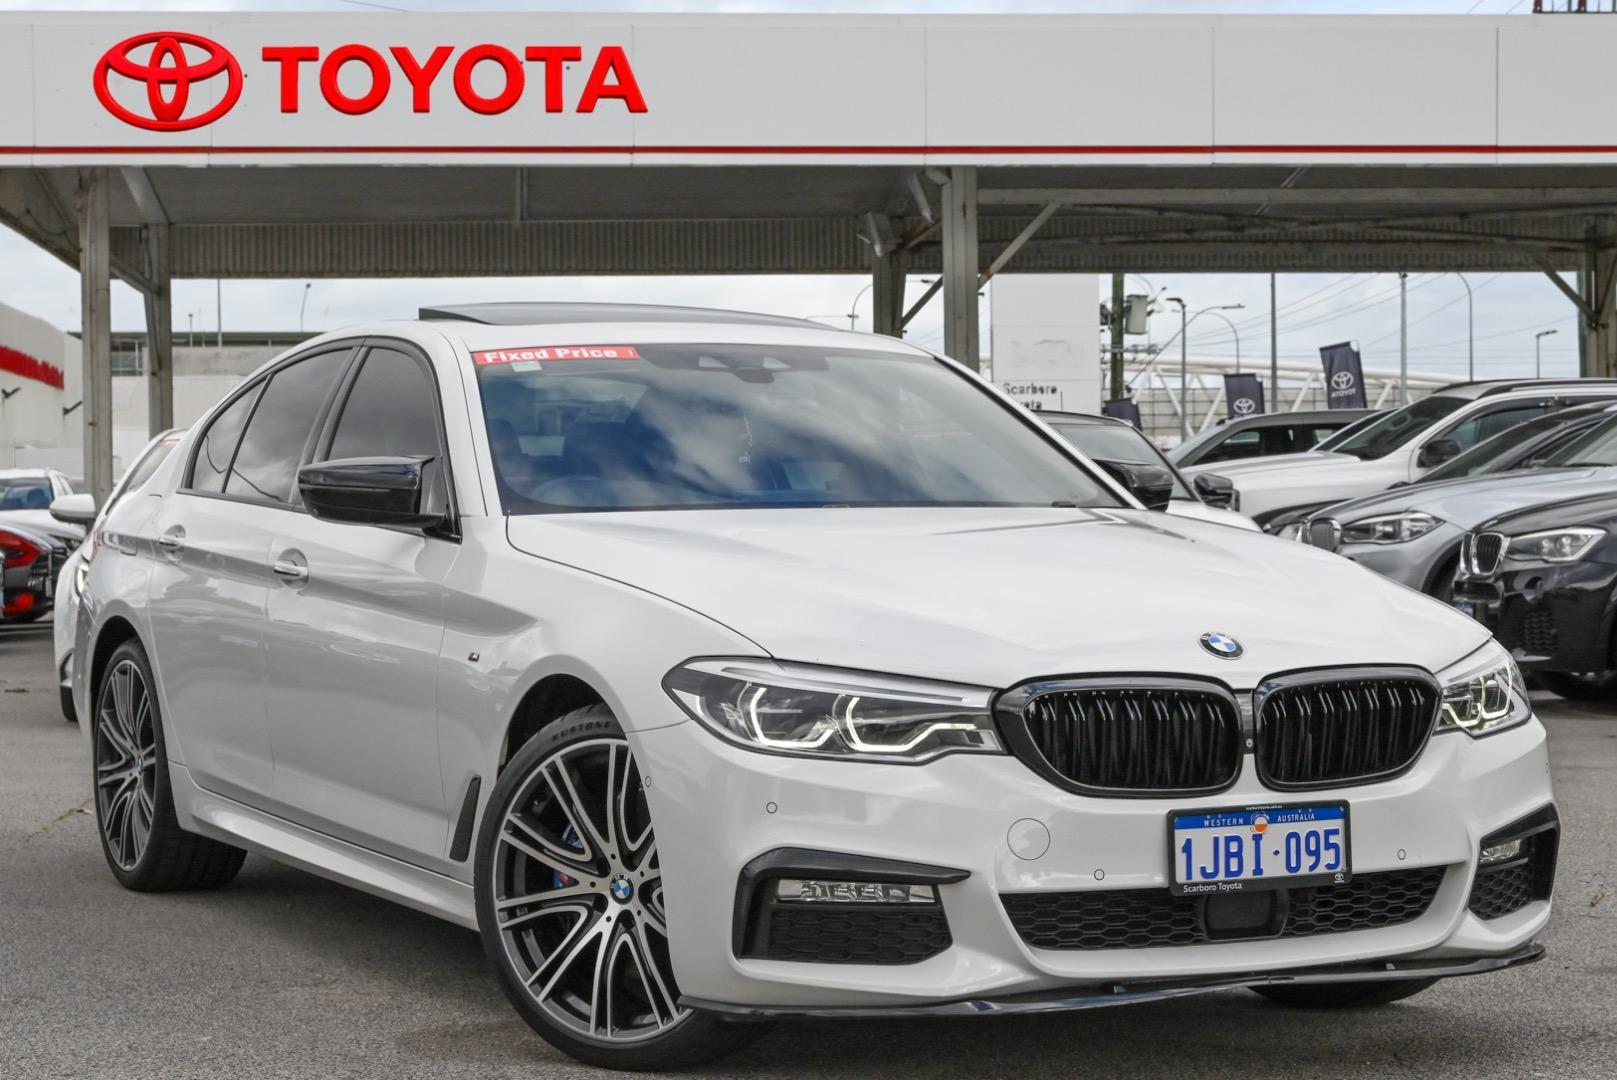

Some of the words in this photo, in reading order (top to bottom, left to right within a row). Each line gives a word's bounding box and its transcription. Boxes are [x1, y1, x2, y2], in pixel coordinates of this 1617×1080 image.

[262, 43, 648, 115] TOYOTA
[484, 349, 549, 363] Fixed
[555, 347, 618, 359] Price
[1203, 817, 1244, 827] WESTERN
[1277, 813, 1316, 823] AUSTRALIA
[1183, 883, 1217, 893] Scarboro
[1218, 882, 1243, 892] Toyota
